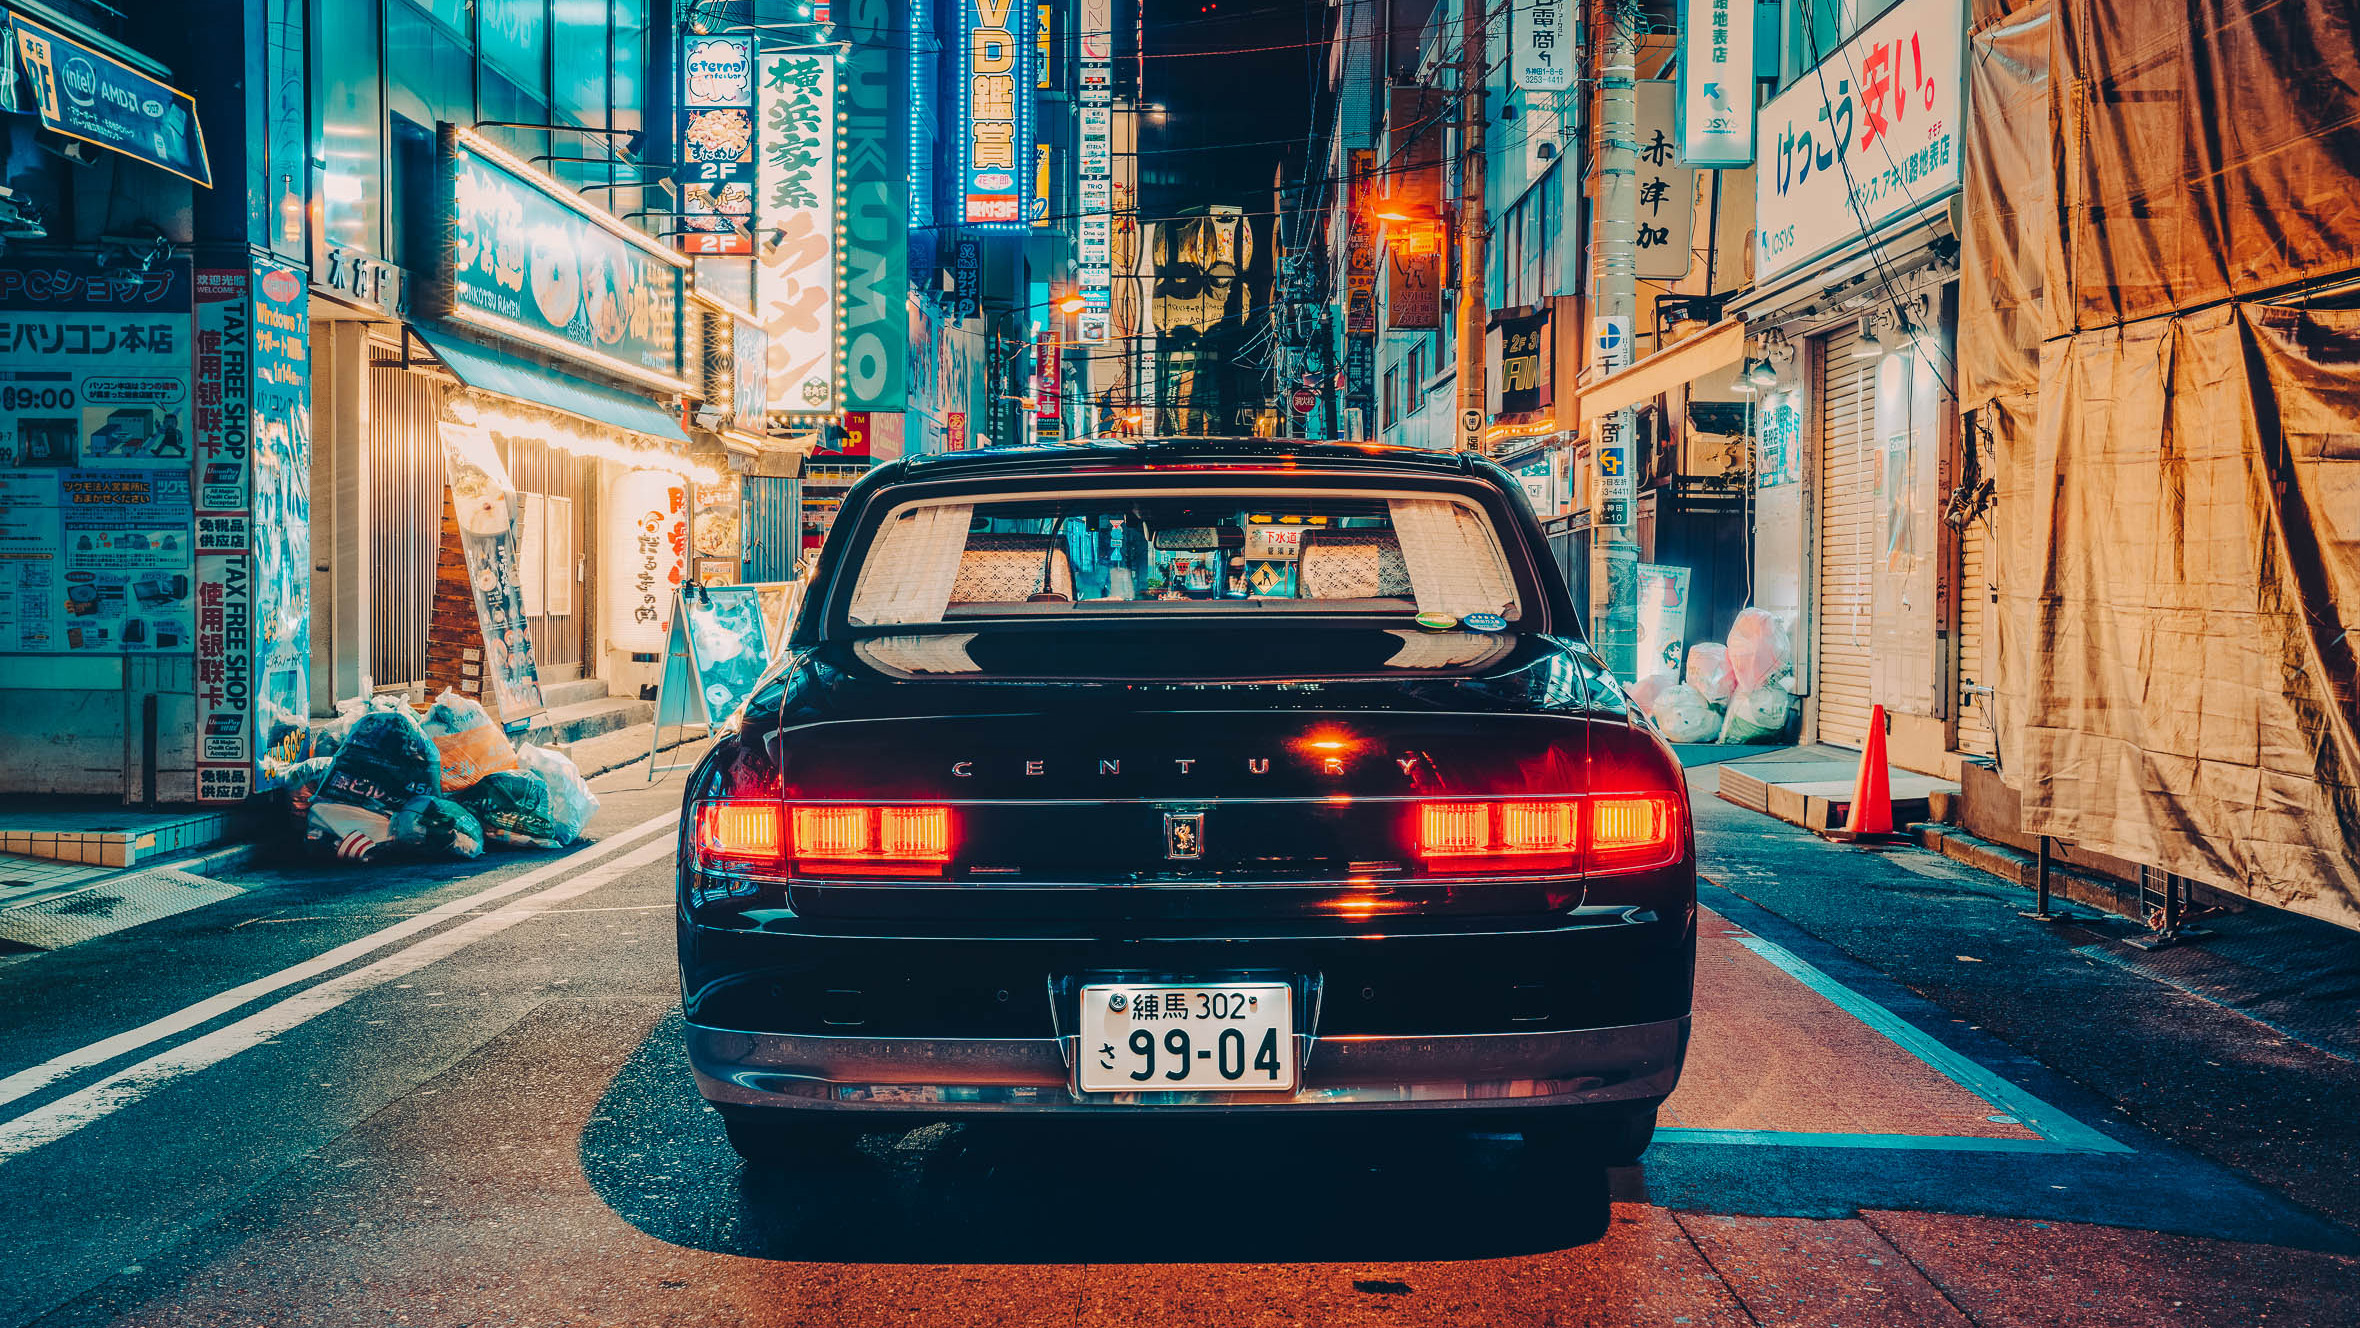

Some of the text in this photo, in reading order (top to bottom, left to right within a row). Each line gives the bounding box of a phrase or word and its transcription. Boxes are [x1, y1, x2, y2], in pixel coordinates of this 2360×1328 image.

[1532, 0, 1555, 48] 電商
[25, 38, 44, 59] 本店
[689, 60, 746, 73] eternal
[66, 68, 91, 95] intel
[101, 80, 129, 111] AMD
[701, 162, 737, 179] 2F
[1882, 133, 1950, 198] アキバ路地表店
[1636, 130, 1674, 249] 赤津加
[701, 236, 736, 252] 2F
[967, 269, 977, 298] メイド
[256, 300, 295, 332] Windows
[497, 295, 521, 319] RAMEN
[1510, 333, 1527, 353] 2F
[1528, 331, 1538, 350] 3
[224, 302, 246, 460] TAX FREE SHOP
[1294, 396, 1315, 406] 消火栓
[853, 415, 865, 424] TM
[1466, 435, 1479, 450] 福
[199, 518, 245, 532] 免税品
[199, 534, 245, 548] 供应店
[1265, 531, 1297, 544] 下水道
[226, 555, 248, 711] TAX FREE SHOP
[199, 582, 224, 710] 使用银联卡
[200, 769, 246, 783] 免税品
[952, 758, 1417, 777] CENTURY
[200, 785, 246, 798] 供应店
[1132, 992, 1247, 1021] 練馬 302
[1098, 1027, 1281, 1082] さ 99-04
